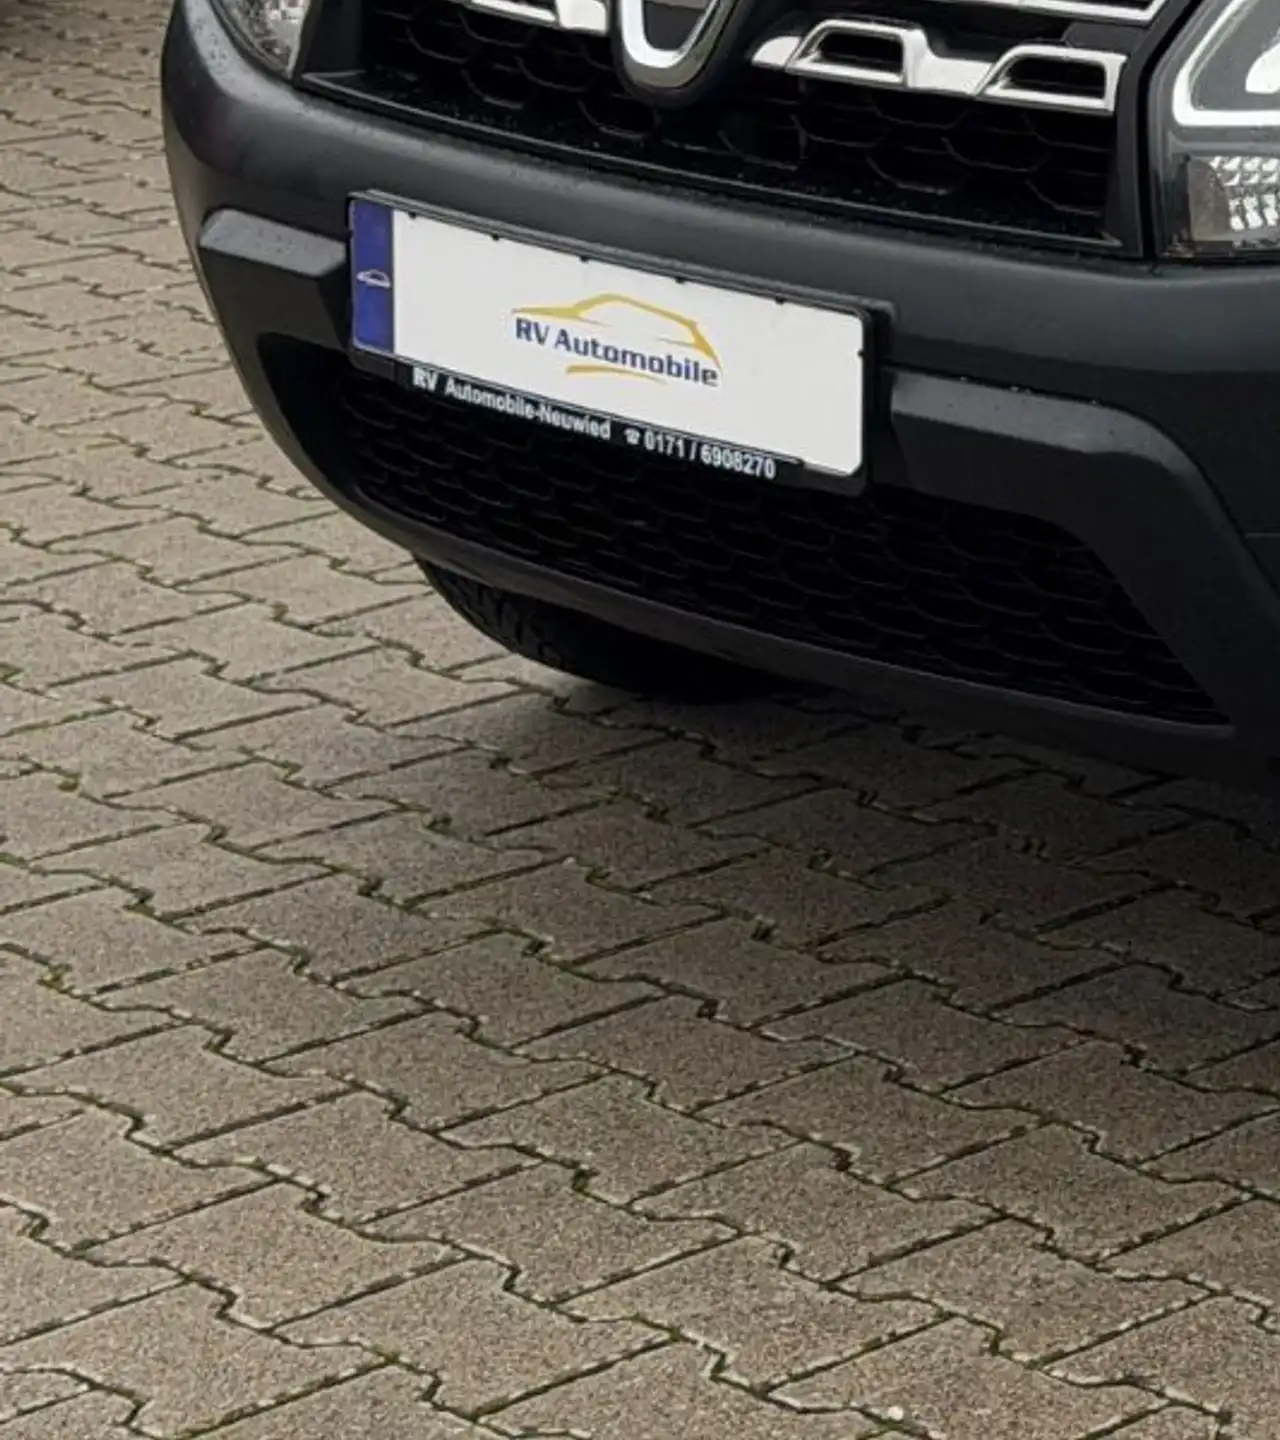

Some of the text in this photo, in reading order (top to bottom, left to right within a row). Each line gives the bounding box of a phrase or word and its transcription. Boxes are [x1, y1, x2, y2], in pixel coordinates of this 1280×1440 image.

[515, 316, 720, 388] RV Automobile
[412, 366, 439, 391] RV
[444, 376, 612, 441] Automobile-Neuwied
